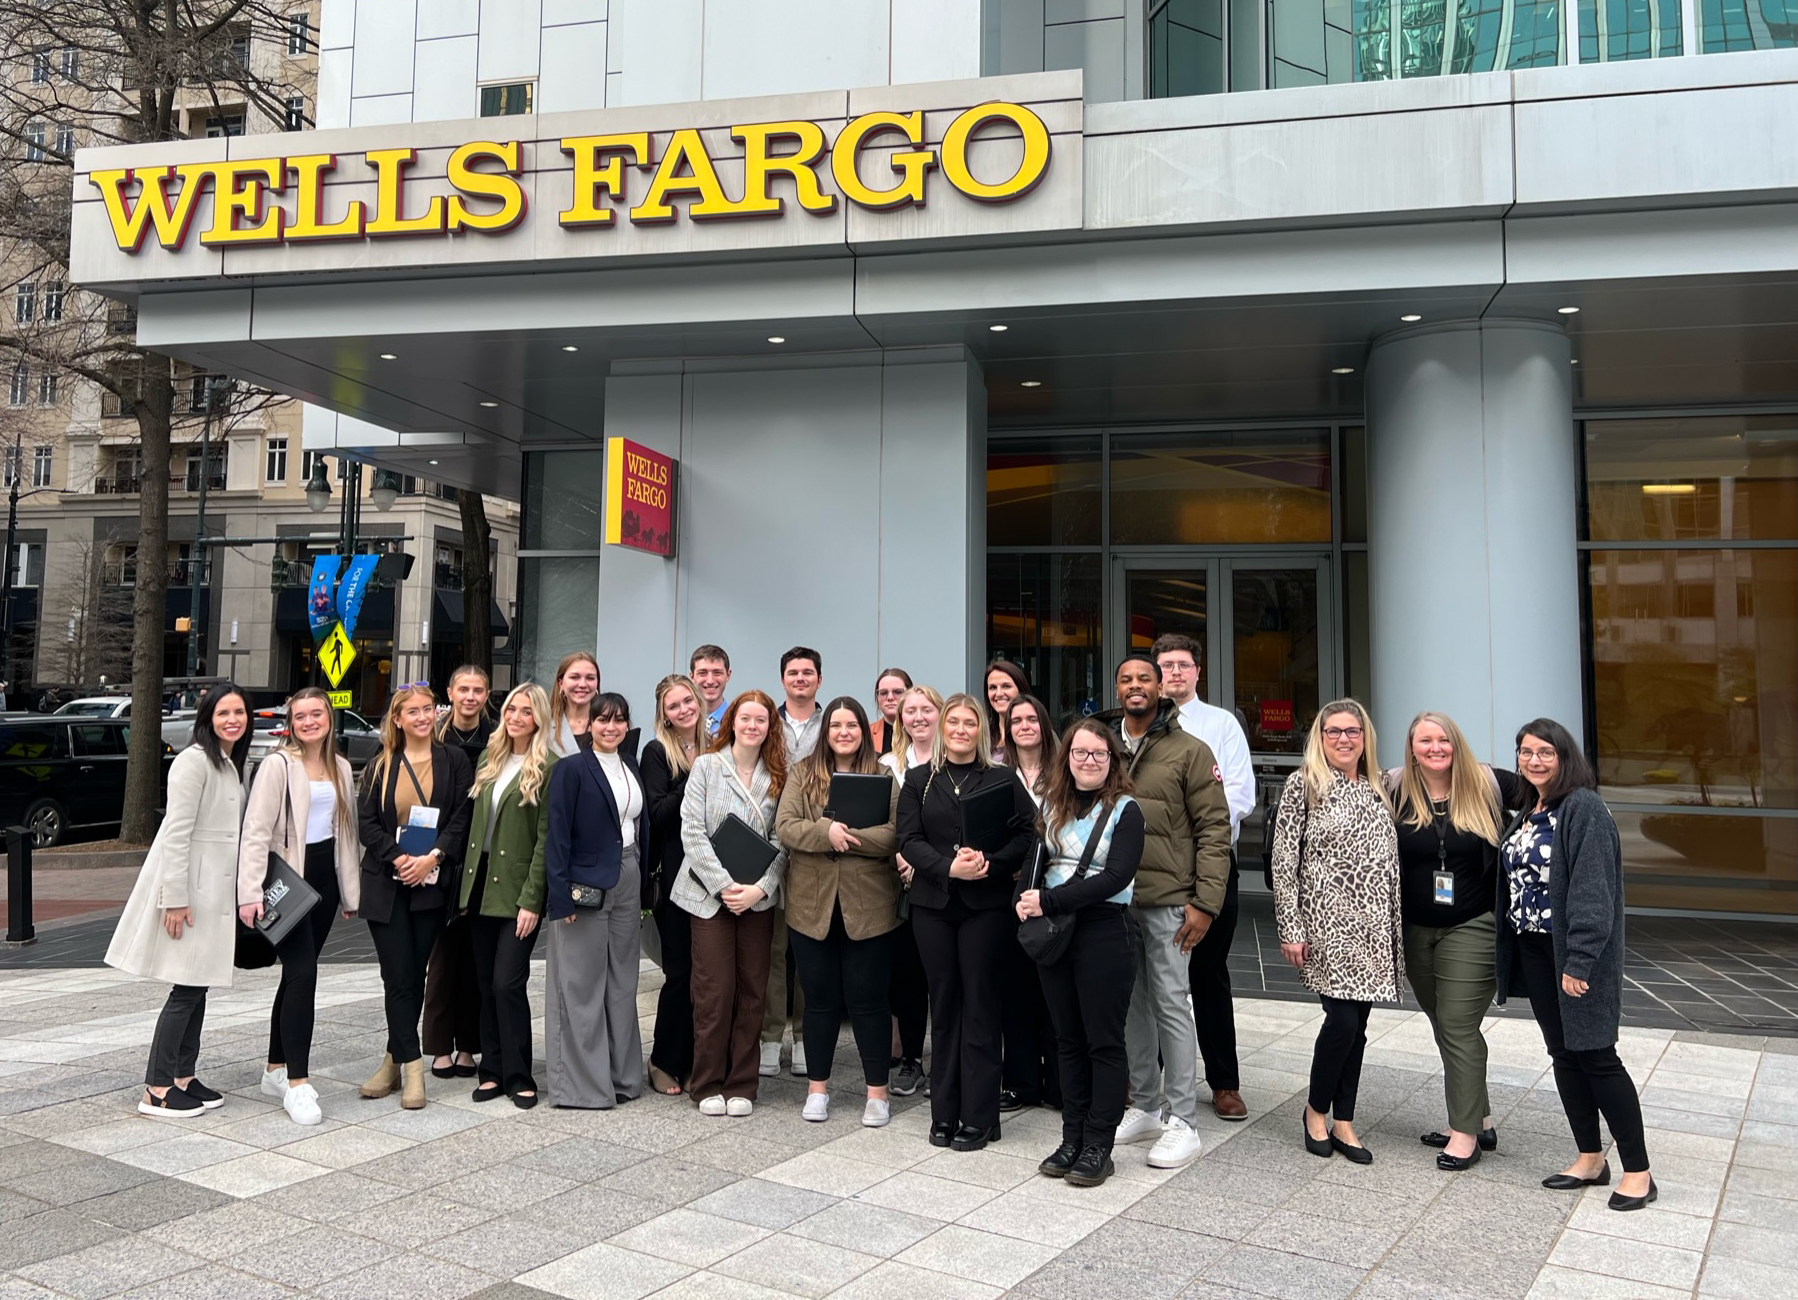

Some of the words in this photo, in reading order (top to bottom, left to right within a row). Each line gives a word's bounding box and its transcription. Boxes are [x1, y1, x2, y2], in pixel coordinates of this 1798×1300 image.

[89, 140, 528, 253] WELLS
[558, 101, 1053, 229] FARGO
[626, 451, 668, 486] WELLS
[626, 477, 667, 509] FARGO
[351, 567, 363, 582] FOR
[346, 582, 358, 598] THE
[330, 695, 348, 704] HEAD
